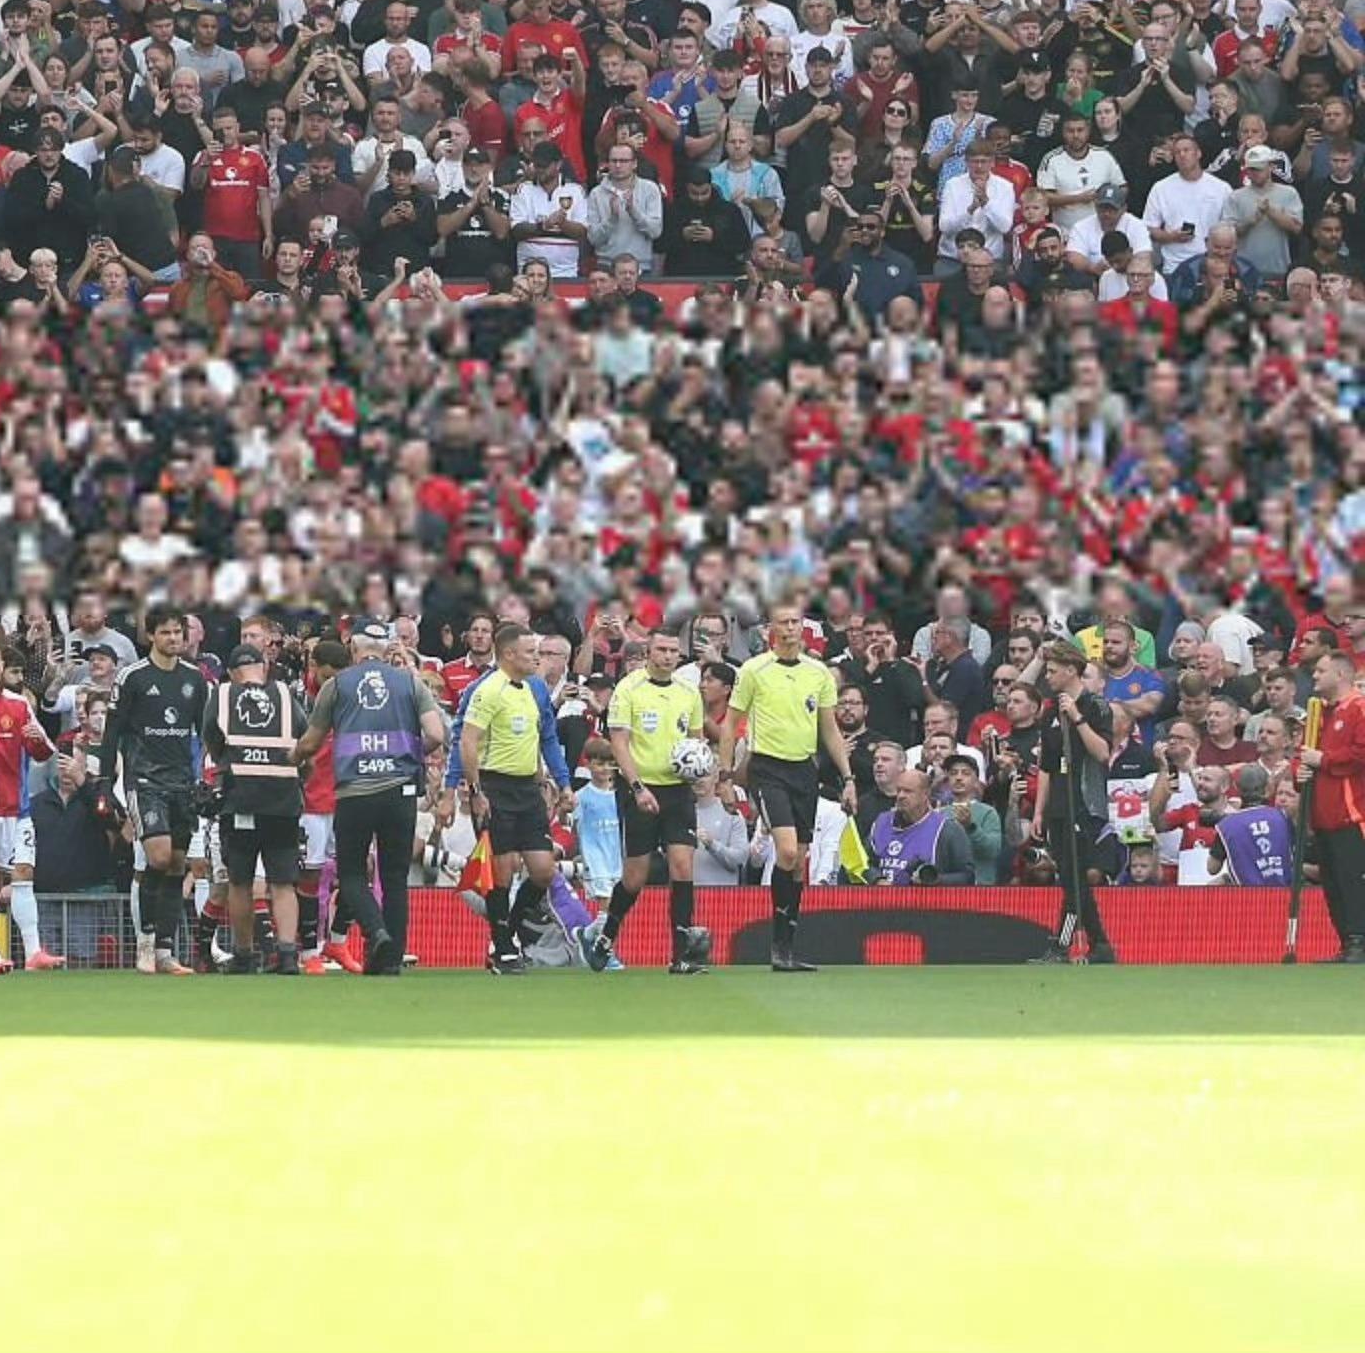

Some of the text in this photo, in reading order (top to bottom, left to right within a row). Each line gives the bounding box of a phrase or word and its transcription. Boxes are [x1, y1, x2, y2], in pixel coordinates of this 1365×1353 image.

[360, 734, 388, 752] RH
[243, 748, 270, 763] 201
[358, 758, 396, 774] 5495
